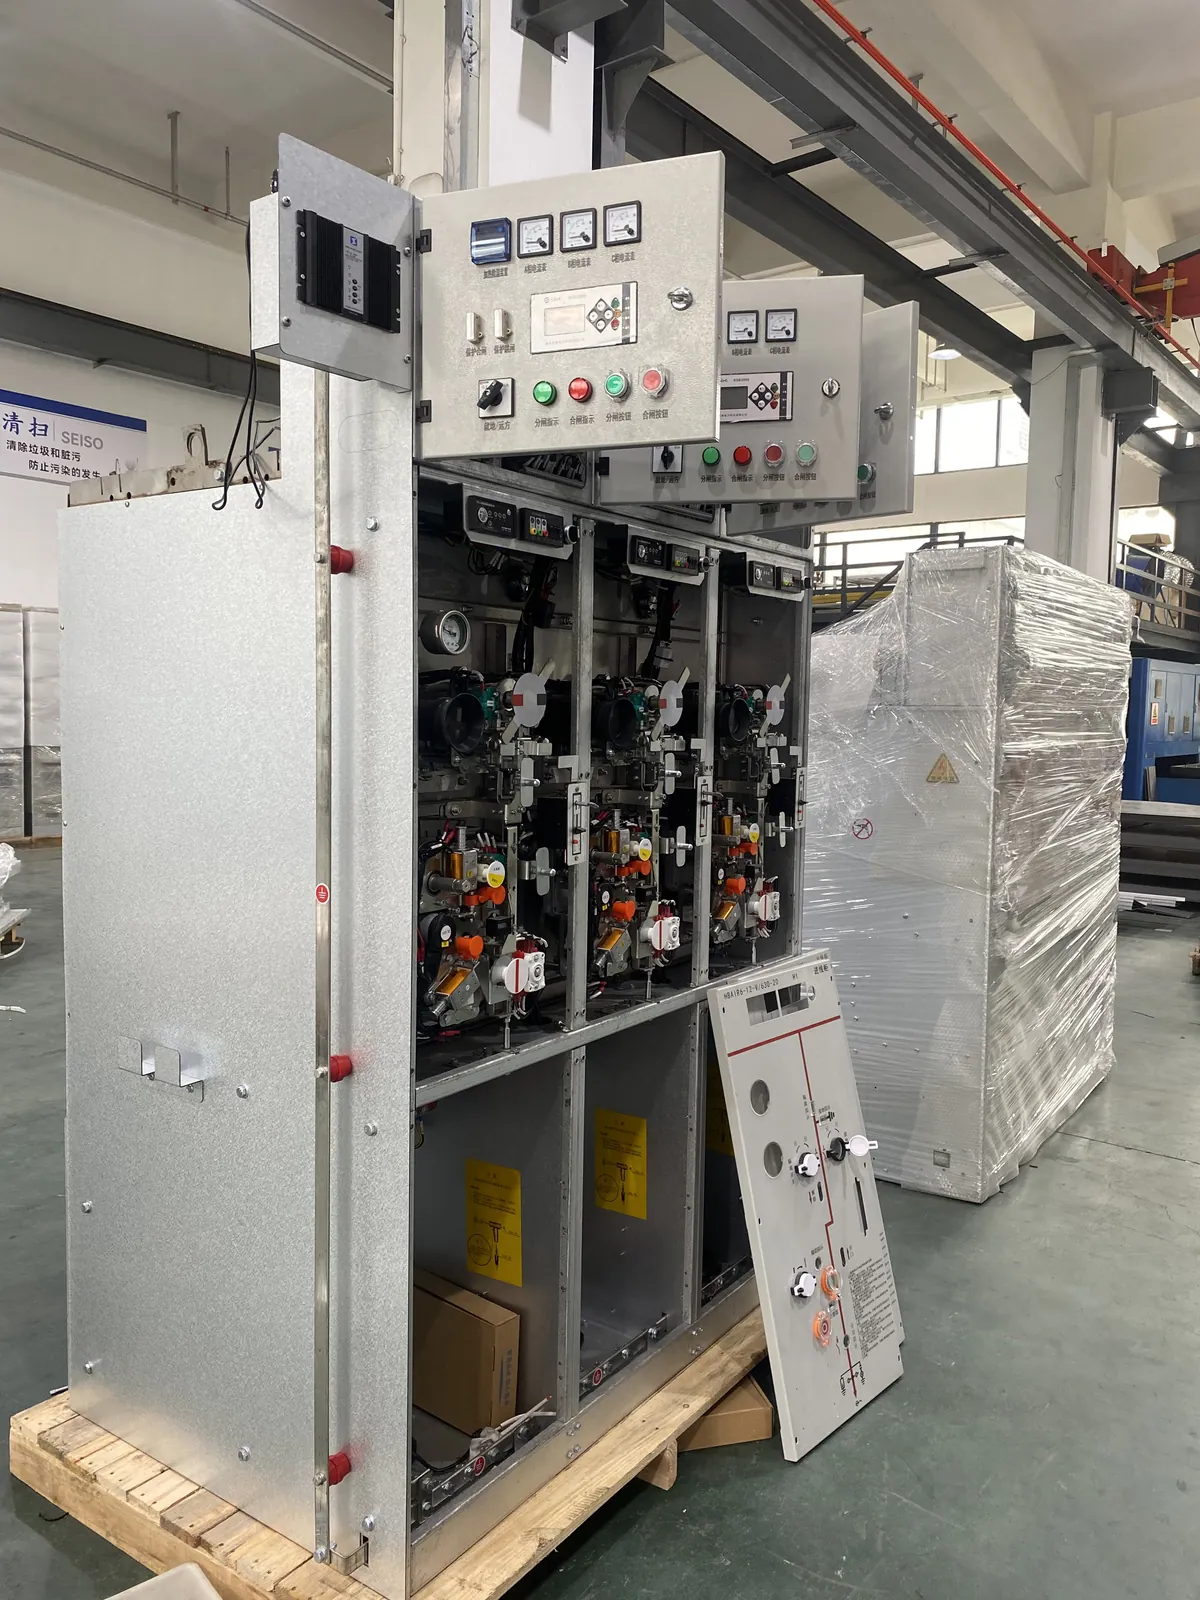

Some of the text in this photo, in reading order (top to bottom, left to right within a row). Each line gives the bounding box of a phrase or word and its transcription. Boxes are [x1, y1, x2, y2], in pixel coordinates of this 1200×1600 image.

[569, 414, 595, 426] 合闸指示
[606, 412, 632, 423] 分闸按钮
[642, 409, 668, 420] 合闸按钮
[534, 416, 560, 428] 分闸指示
[2, 412, 104, 450] 清扫 SEISO
[6, 439, 81, 462] 清除垃圾和脏污
